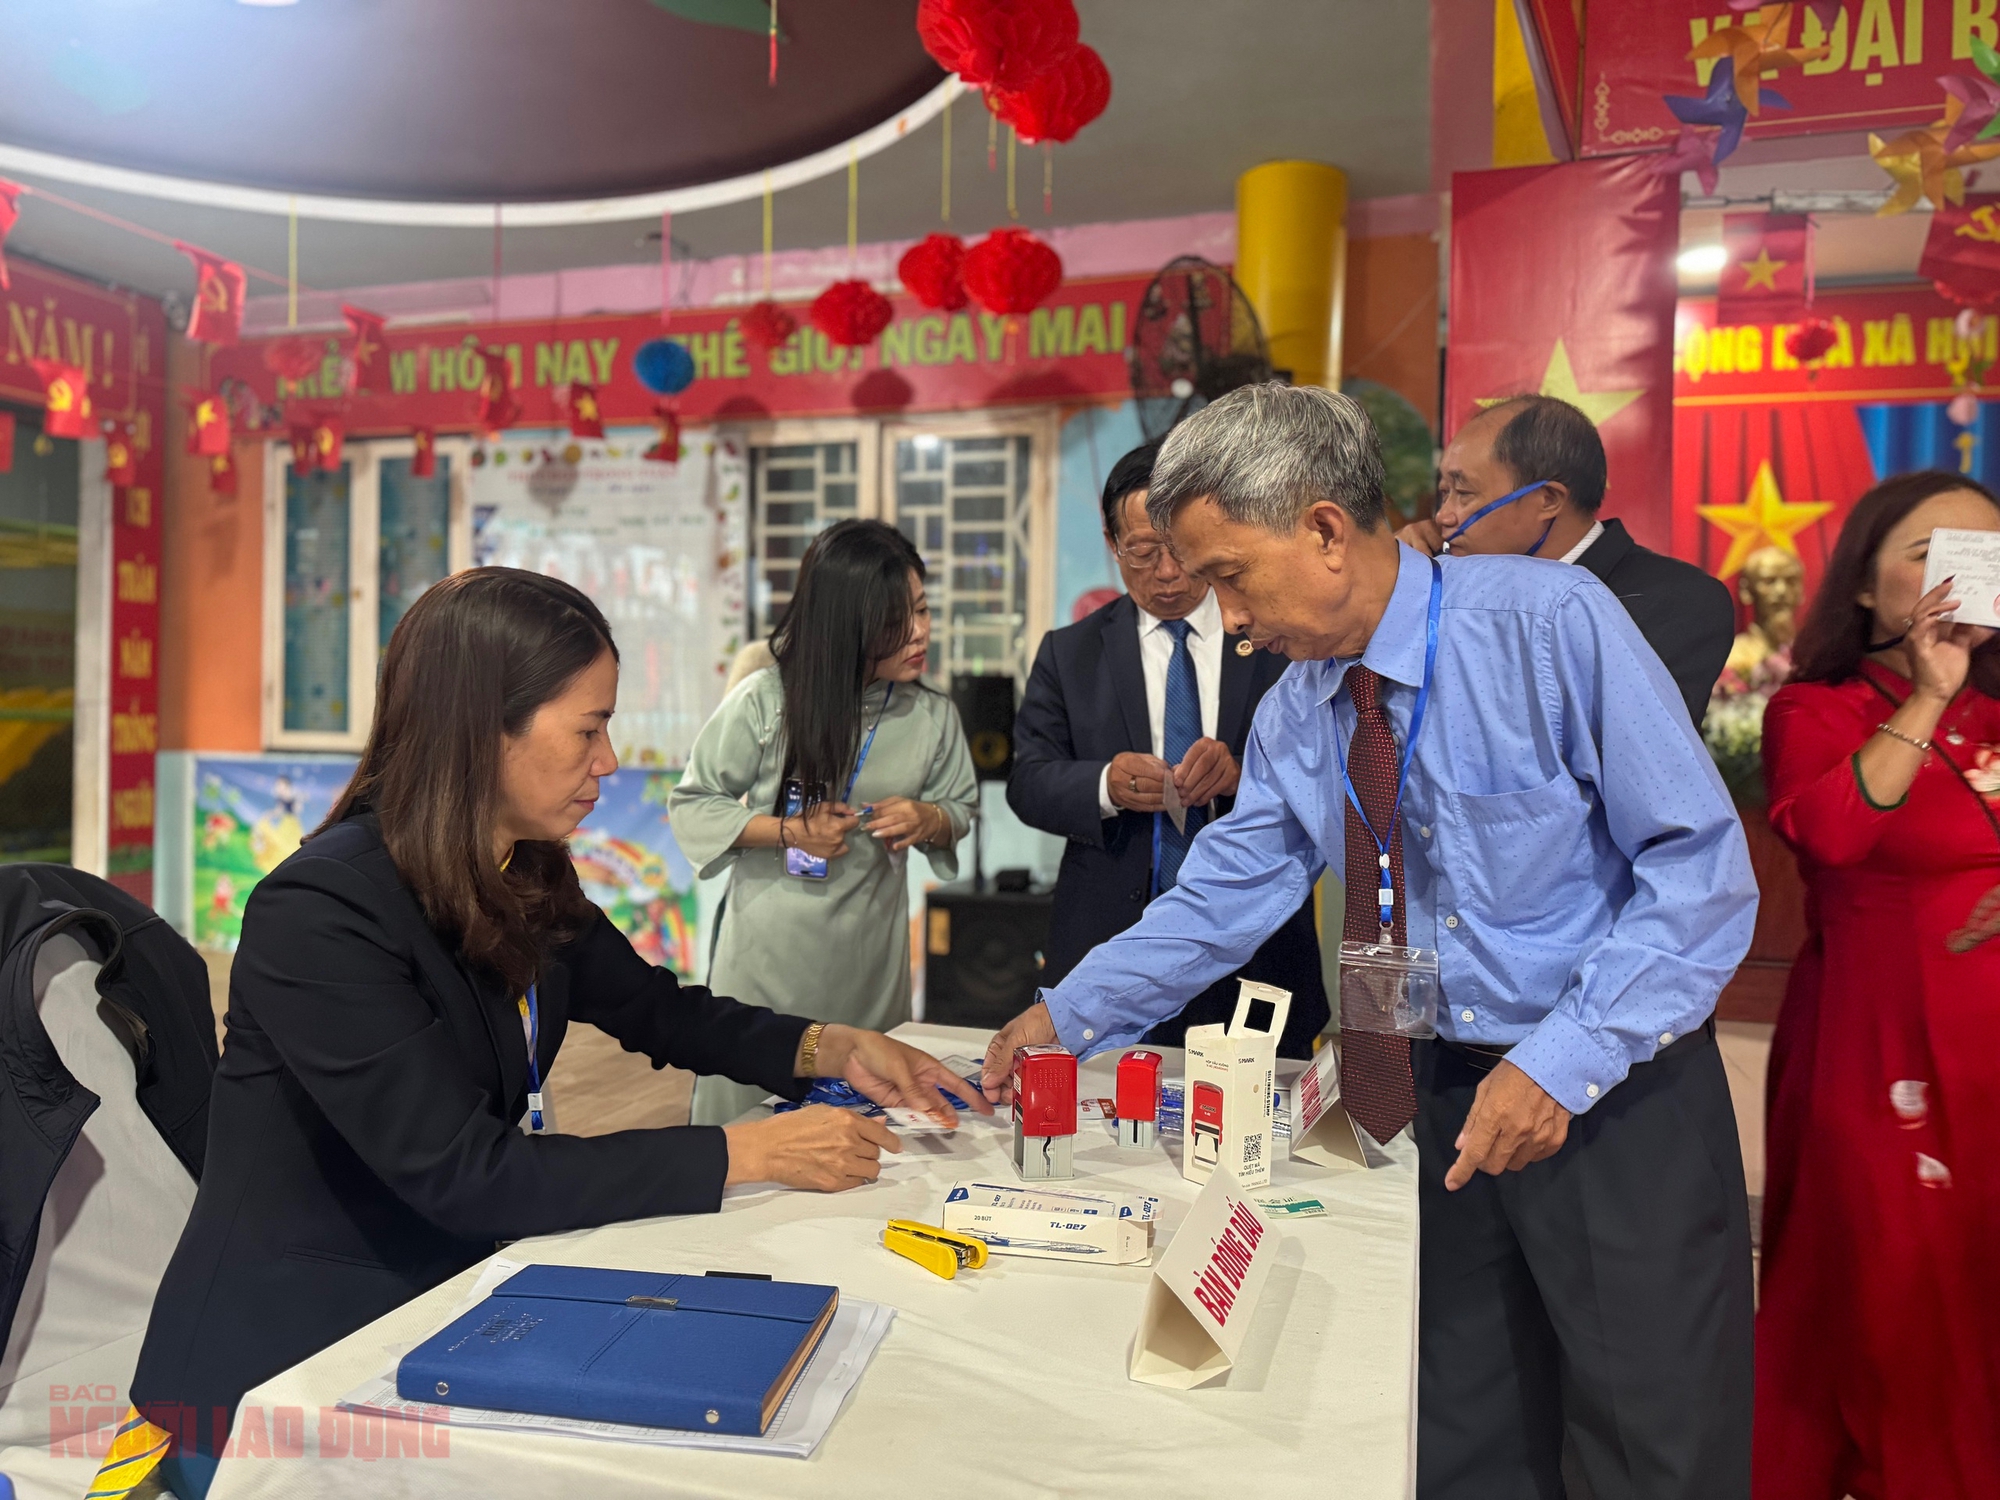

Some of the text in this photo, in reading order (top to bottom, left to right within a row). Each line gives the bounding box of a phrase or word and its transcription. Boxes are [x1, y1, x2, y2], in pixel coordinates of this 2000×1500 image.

[1029, 302, 1126, 358] MAI
[535, 337, 620, 388] NAY
[1050, 1221, 1087, 1231] TL-027
[1226, 1195, 1264, 1252] DẤU
[1211, 1237, 1254, 1291] ĐÓNG
[1193, 1270, 1236, 1328] BÀN
